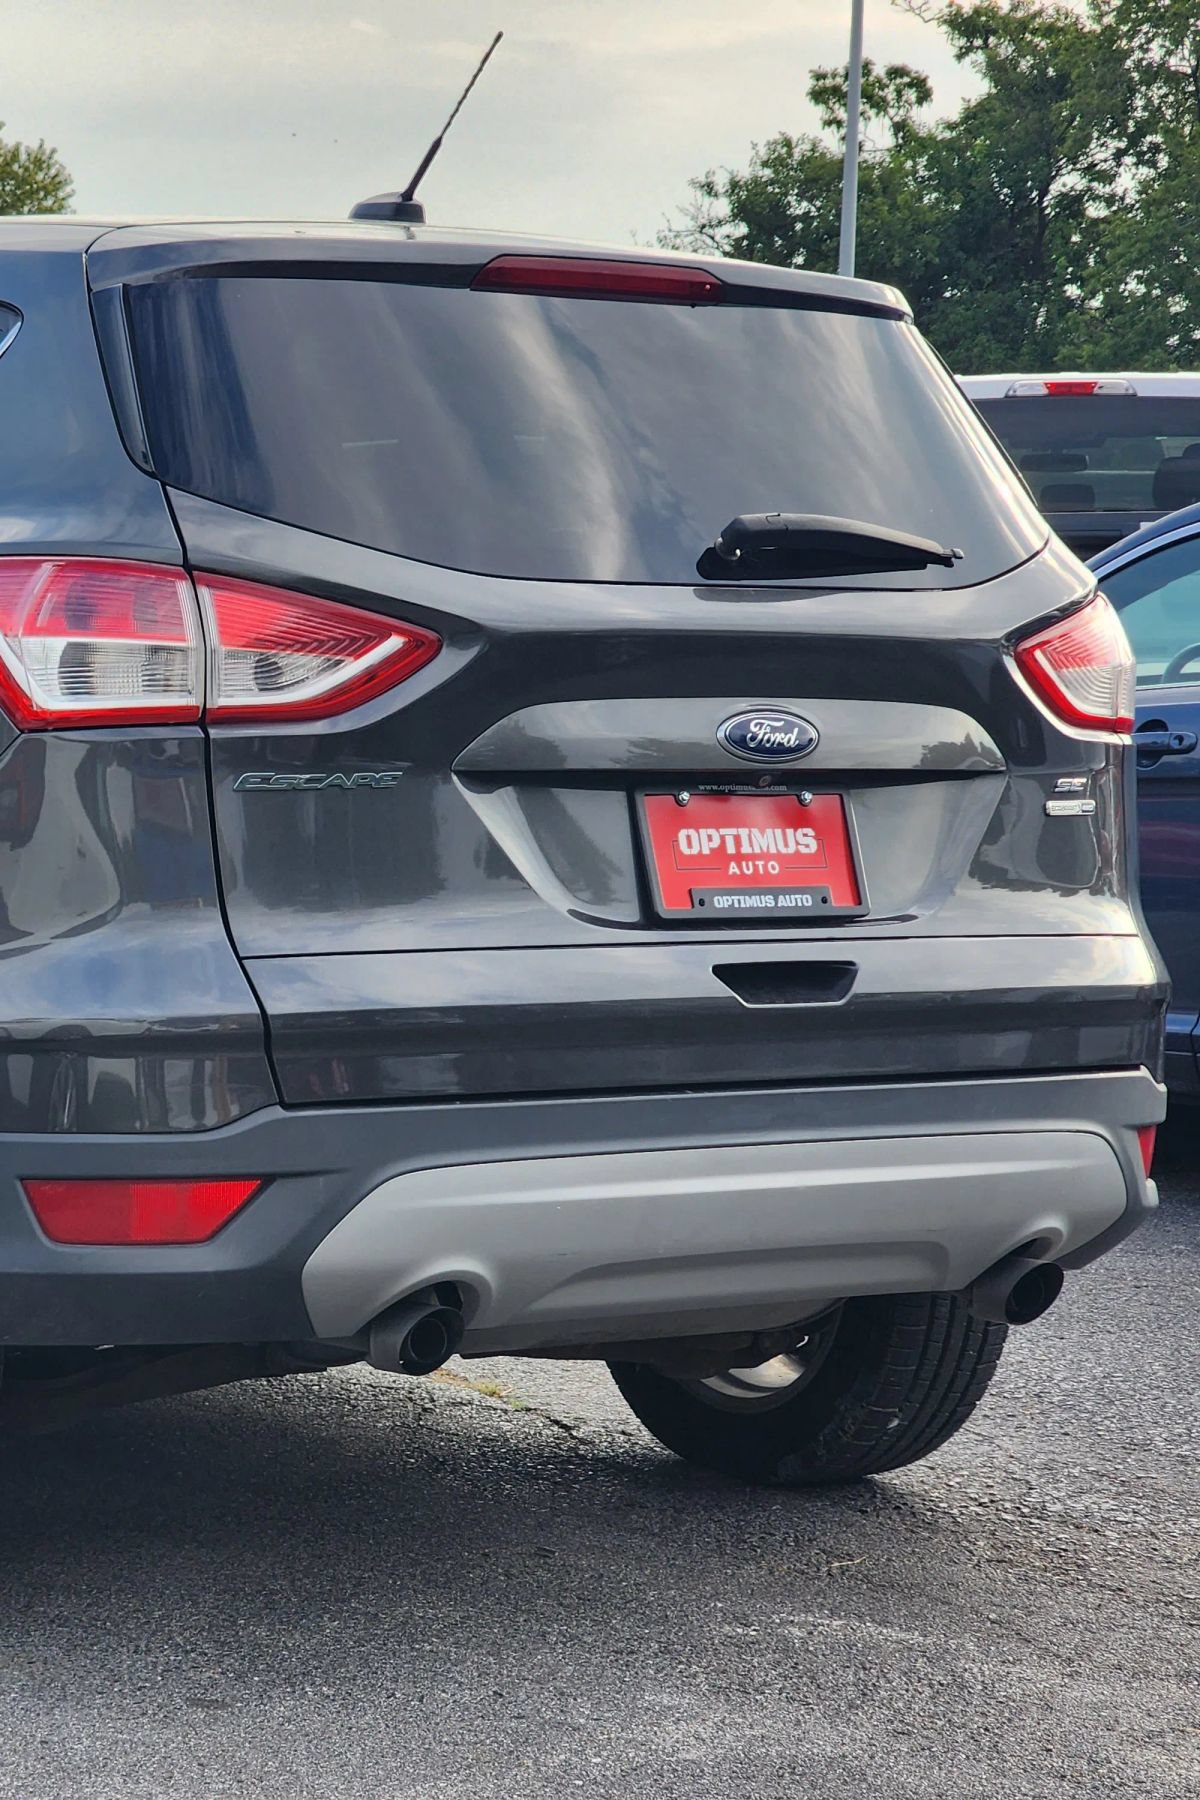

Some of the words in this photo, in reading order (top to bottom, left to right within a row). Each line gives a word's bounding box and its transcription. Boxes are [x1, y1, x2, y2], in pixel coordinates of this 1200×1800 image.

[746, 719, 800, 748] Ford
[233, 772, 403, 791] ESCAPE
[677, 827, 818, 855] OPTIMUS
[728, 860, 780, 875] AUTO
[713, 895, 775, 908] OPTIMUS
[777, 894, 813, 907] AUTO
